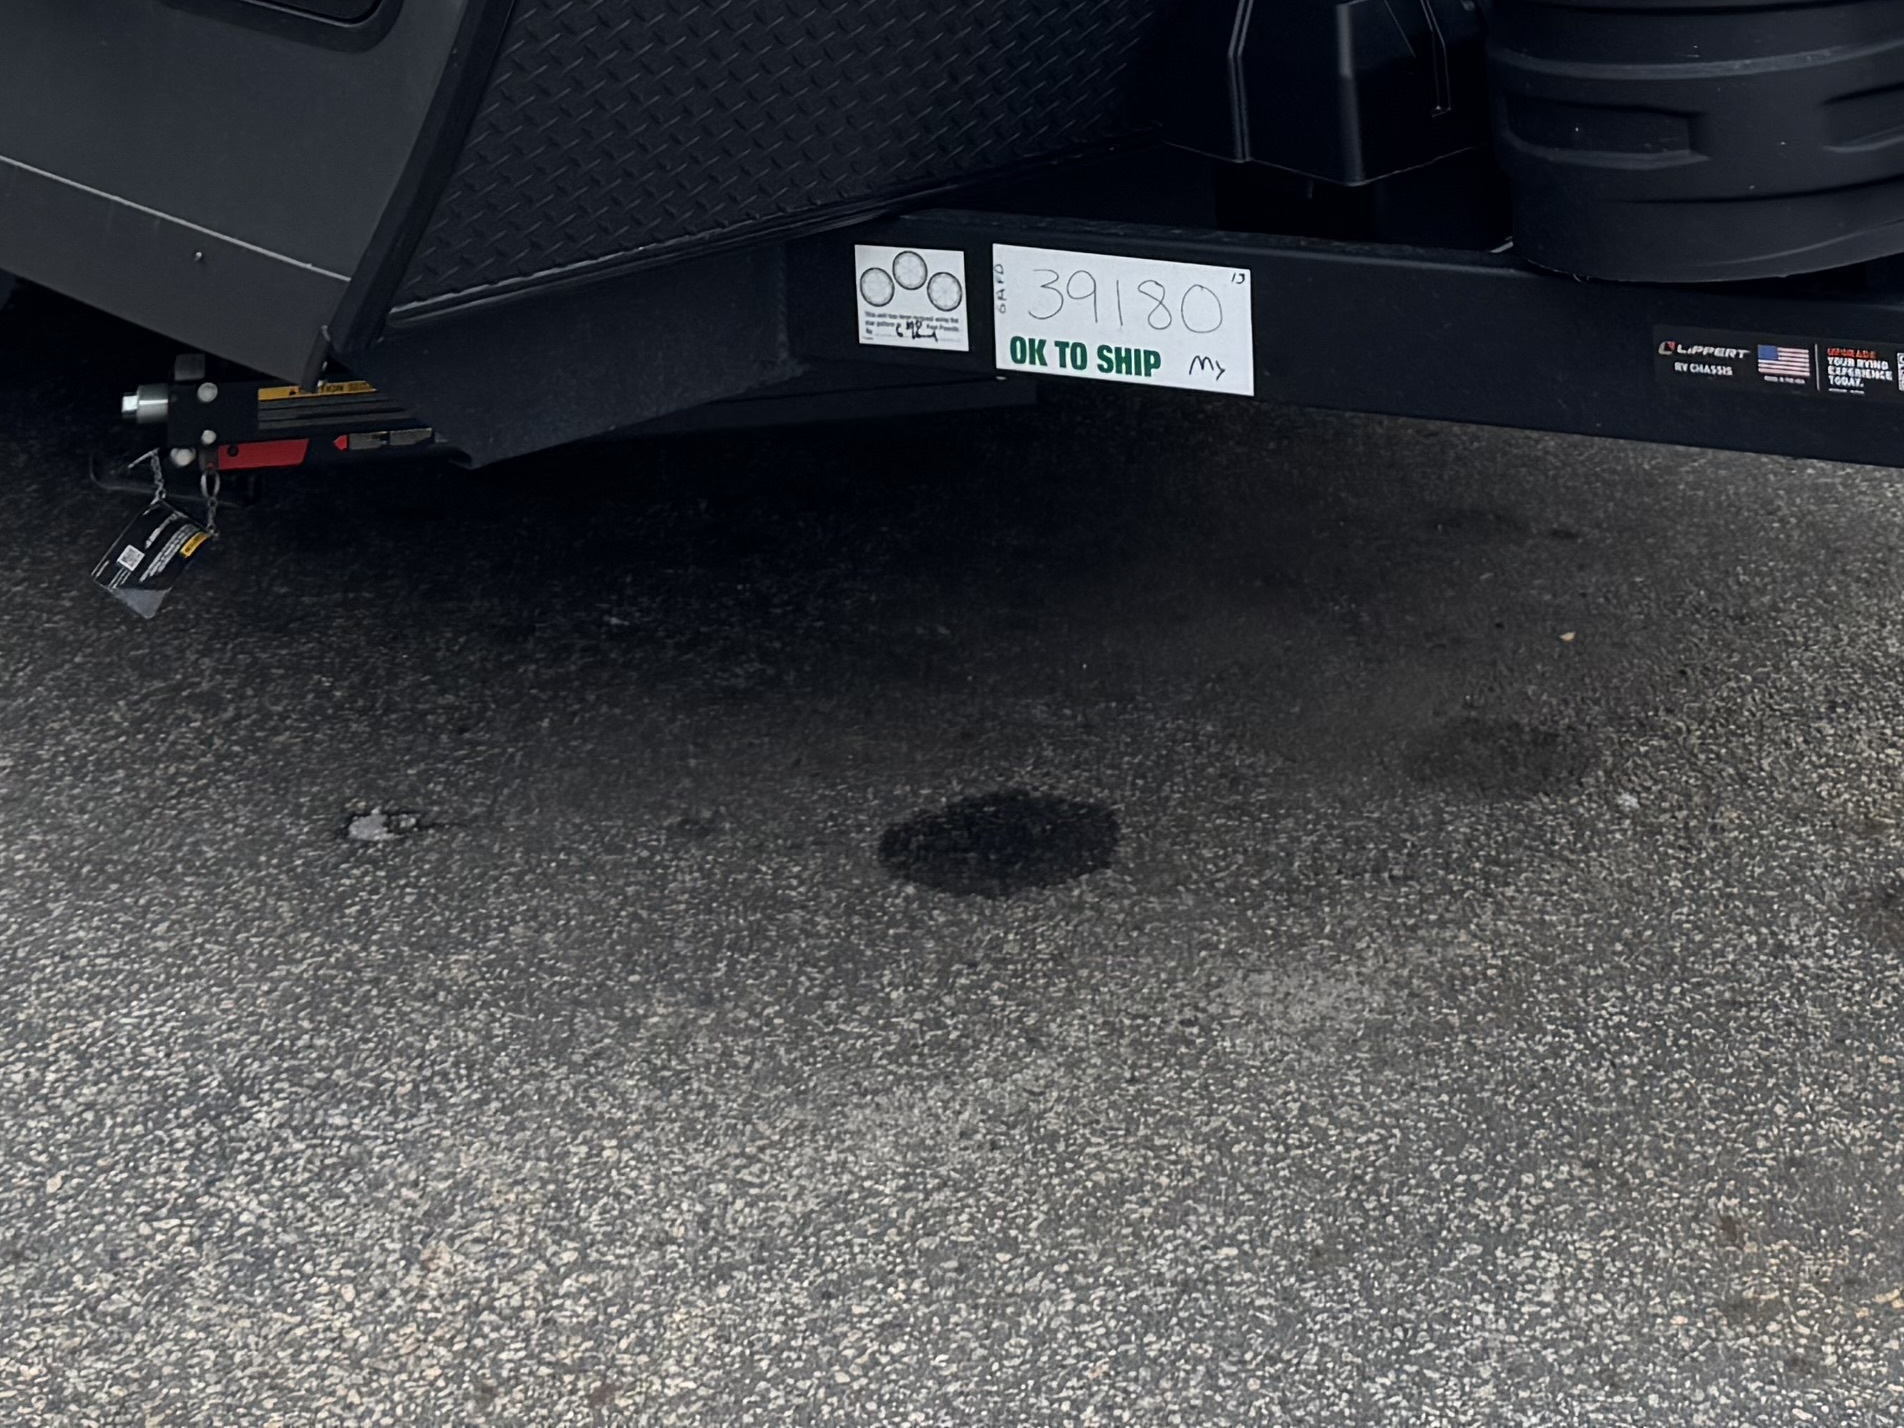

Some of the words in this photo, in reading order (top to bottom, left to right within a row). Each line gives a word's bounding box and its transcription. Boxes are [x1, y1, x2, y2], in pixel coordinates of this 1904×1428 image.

[1027, 268, 1223, 334] 39180
[1010, 335, 1048, 367] OK
[1054, 340, 1088, 371] TO
[1096, 344, 1162, 377] SHIP
[1676, 343, 1752, 359] LIPPERT
